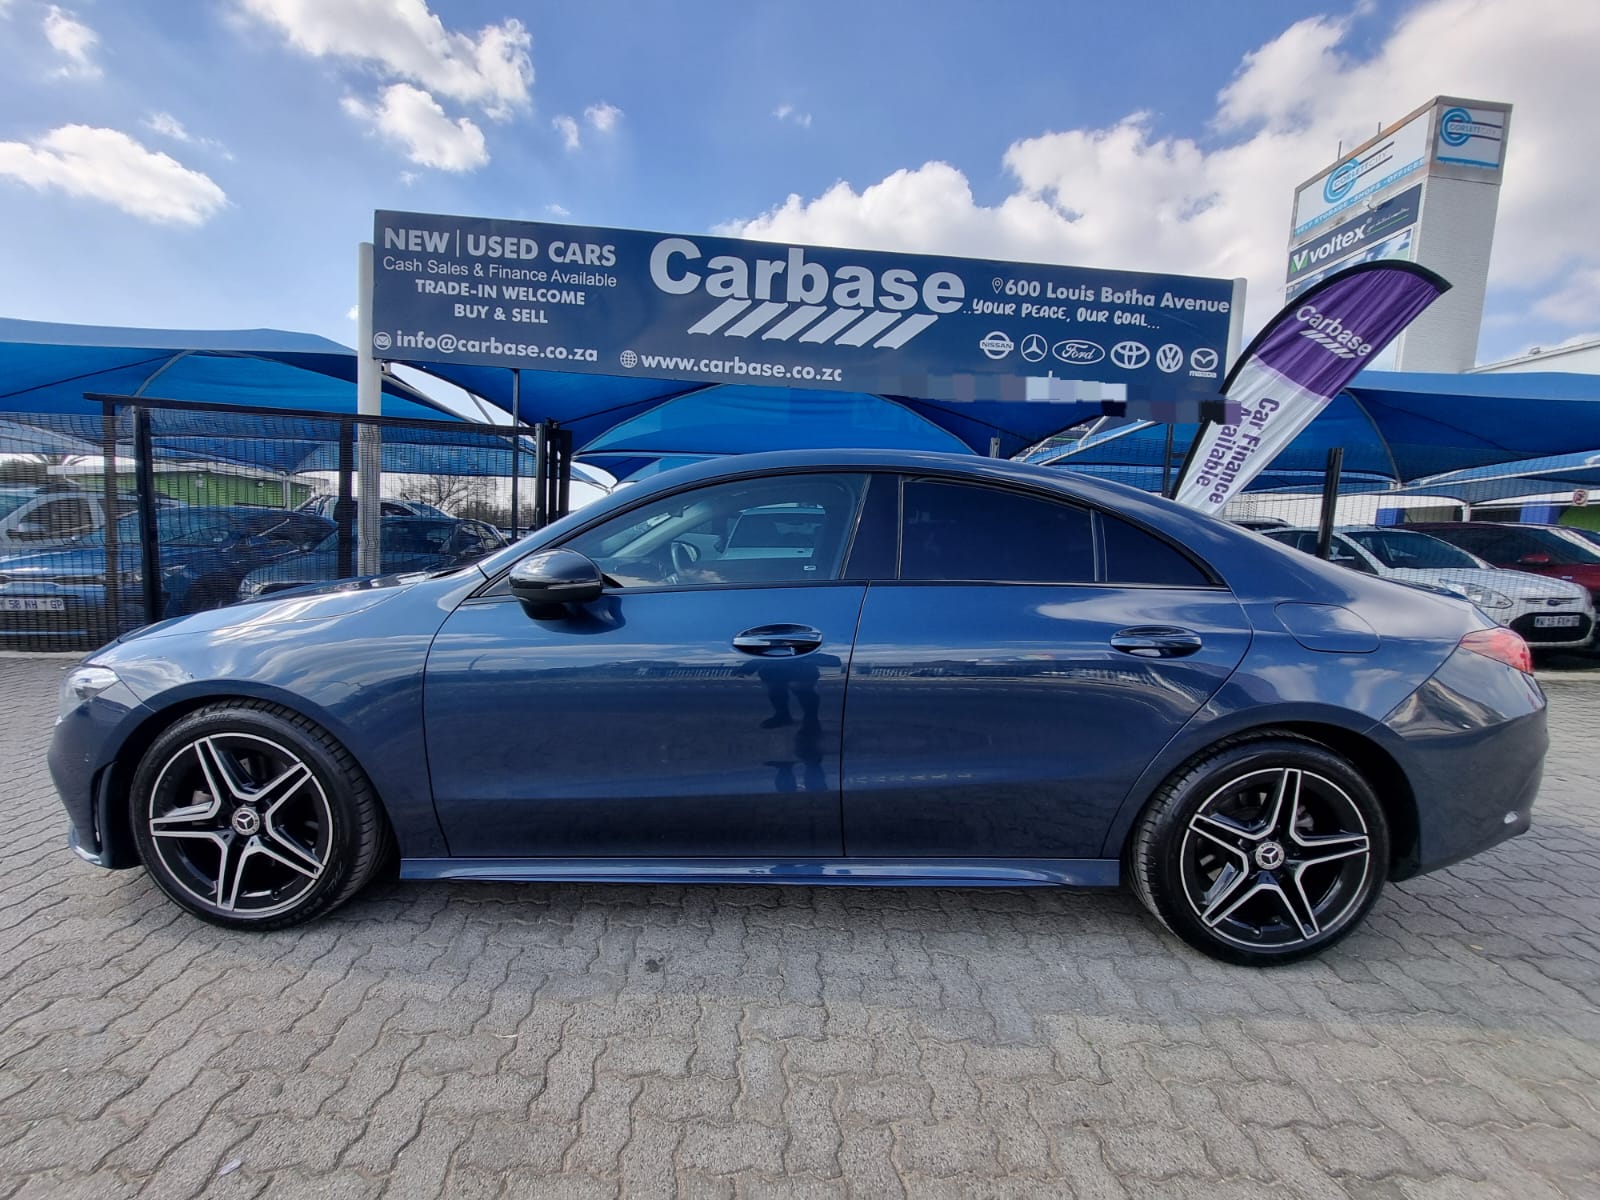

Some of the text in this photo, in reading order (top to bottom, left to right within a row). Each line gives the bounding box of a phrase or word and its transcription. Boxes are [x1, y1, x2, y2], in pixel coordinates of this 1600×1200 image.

[384, 227, 616, 267] NEW USED CARS
[1308, 223, 1368, 264] voltex
[383, 256, 617, 287] Cash Sales & Finance Available
[650, 238, 965, 313] Carbase
[416, 279, 585, 305] TRADE-IN WELCOME
[1005, 279, 1230, 313] 600 Louis Botha Avenue
[454, 303, 548, 324] BUY & SELL
[397, 330, 598, 362] info@carbase.co.za
[981, 341, 1012, 350] NISSAN
[1296, 305, 1372, 357] Carbase
[1062, 343, 1096, 360] Ford
[1196, 405, 1252, 487] ailable
[1209, 398, 1280, 504] Car Finance
